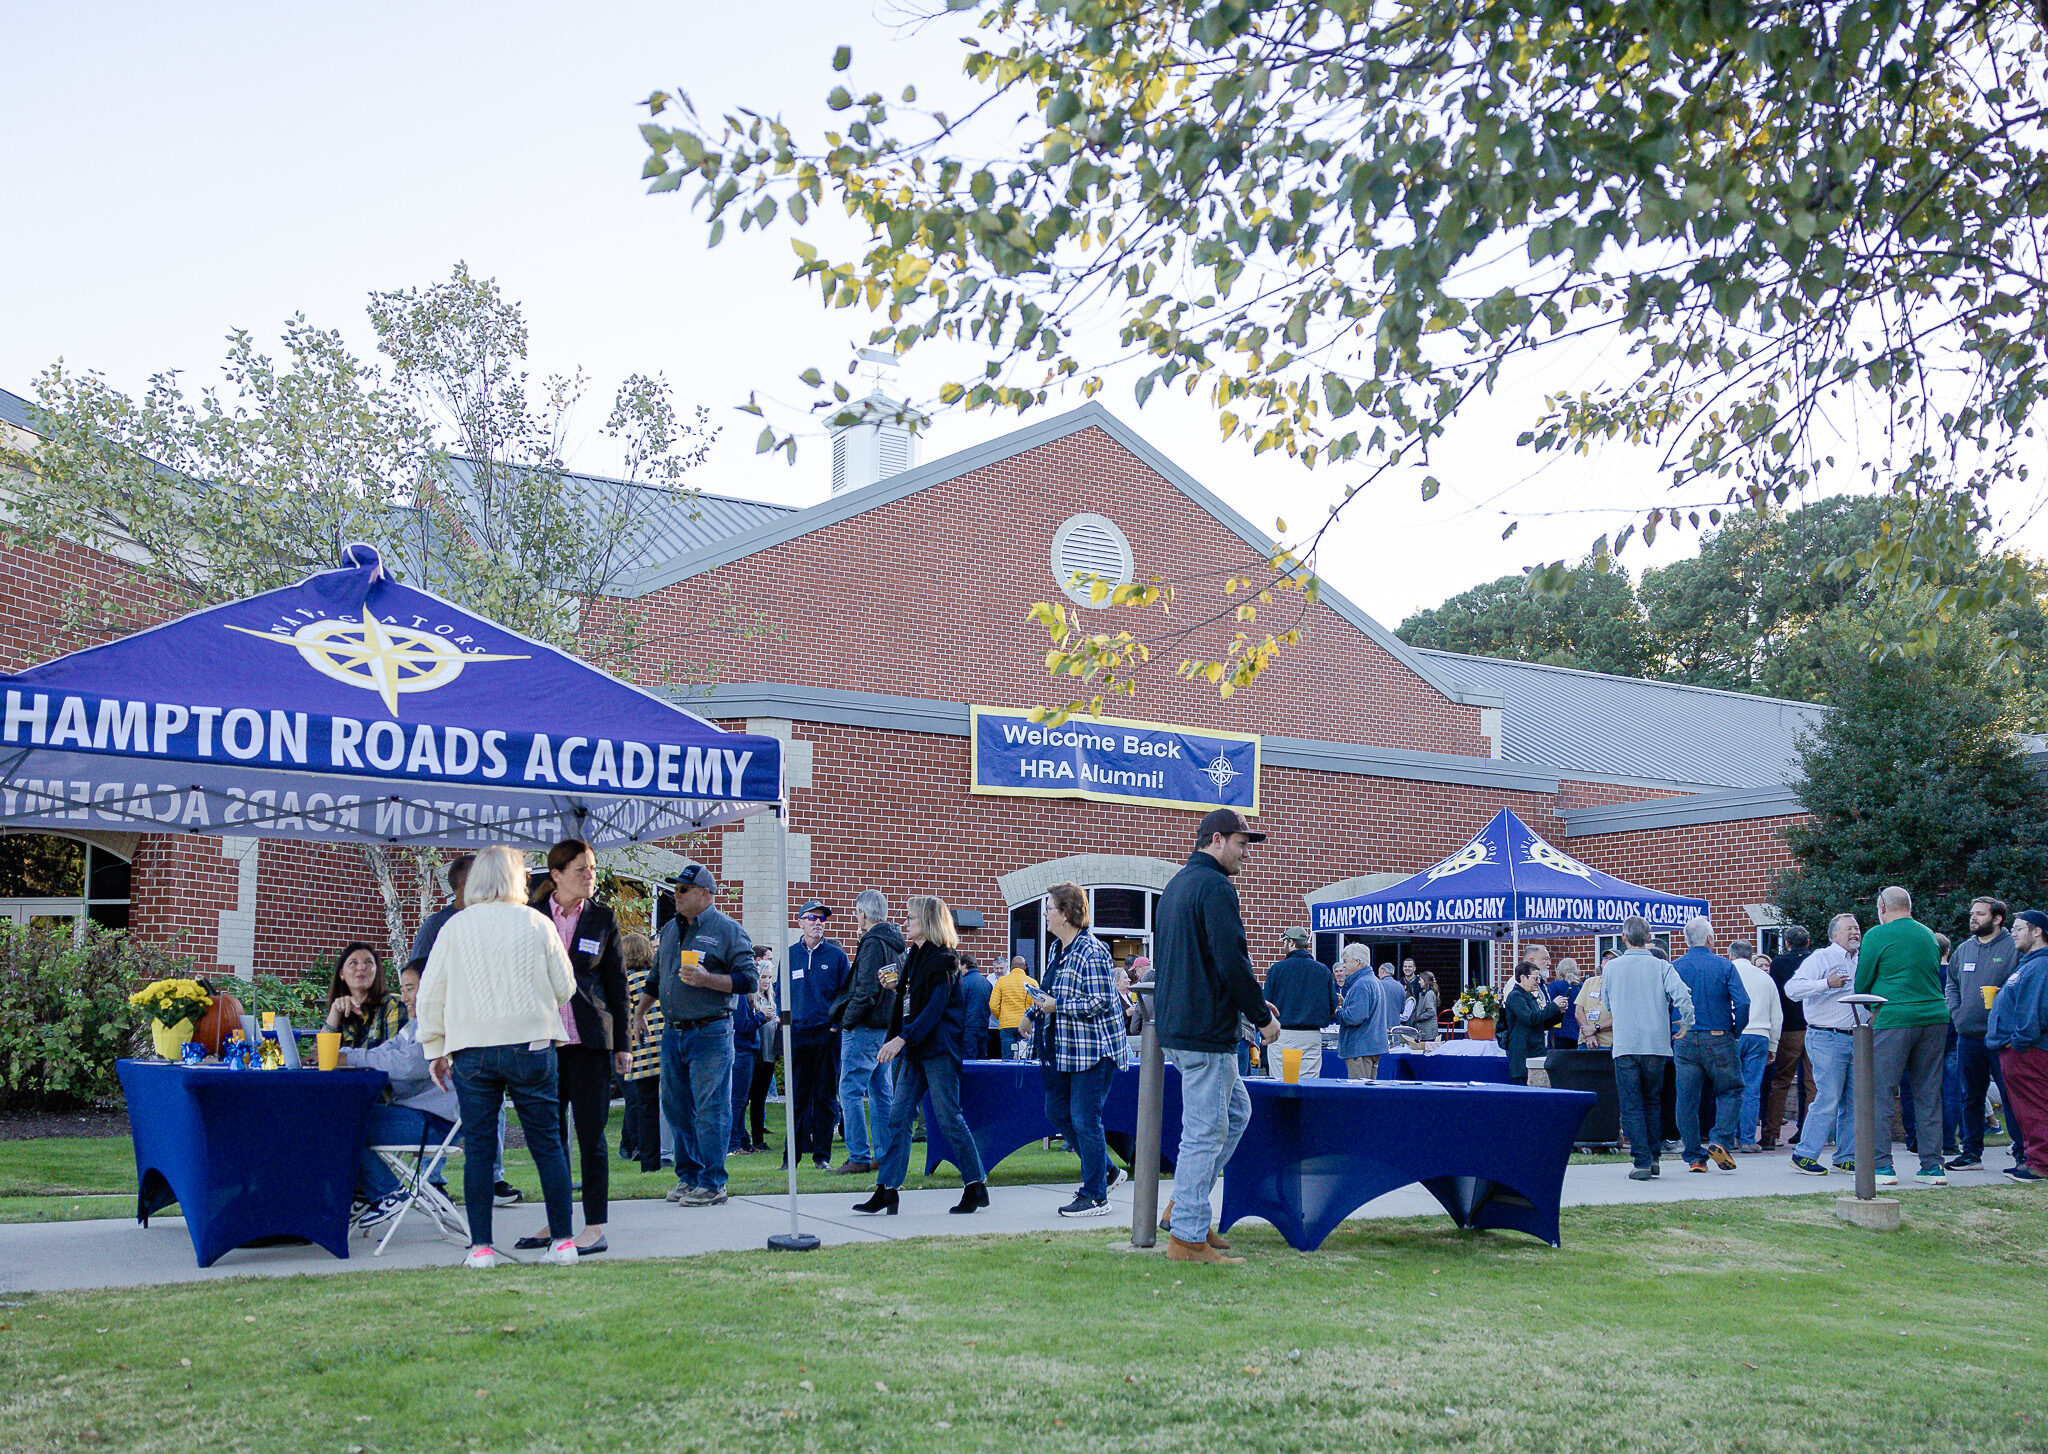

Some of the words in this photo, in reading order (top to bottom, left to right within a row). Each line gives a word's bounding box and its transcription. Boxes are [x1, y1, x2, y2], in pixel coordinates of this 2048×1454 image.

[3, 690, 308, 764] HAMPTON
[330, 716, 508, 778] ROADS
[523, 733, 754, 798] ACADEMY
[1002, 724, 1116, 751] Welcome
[1123, 735, 1182, 760] Back
[1020, 758, 1075, 779] HRA
[1080, 762, 1165, 789] Alumni!
[1319, 903, 1383, 928] HAMPTON
[1387, 900, 1432, 923] ROADS
[1435, 897, 1506, 920] ACADEMY
[1525, 897, 1593, 920] HAMPTON
[1597, 899, 1640, 921] ROADS
[1643, 902, 1702, 924] ACADEMY
